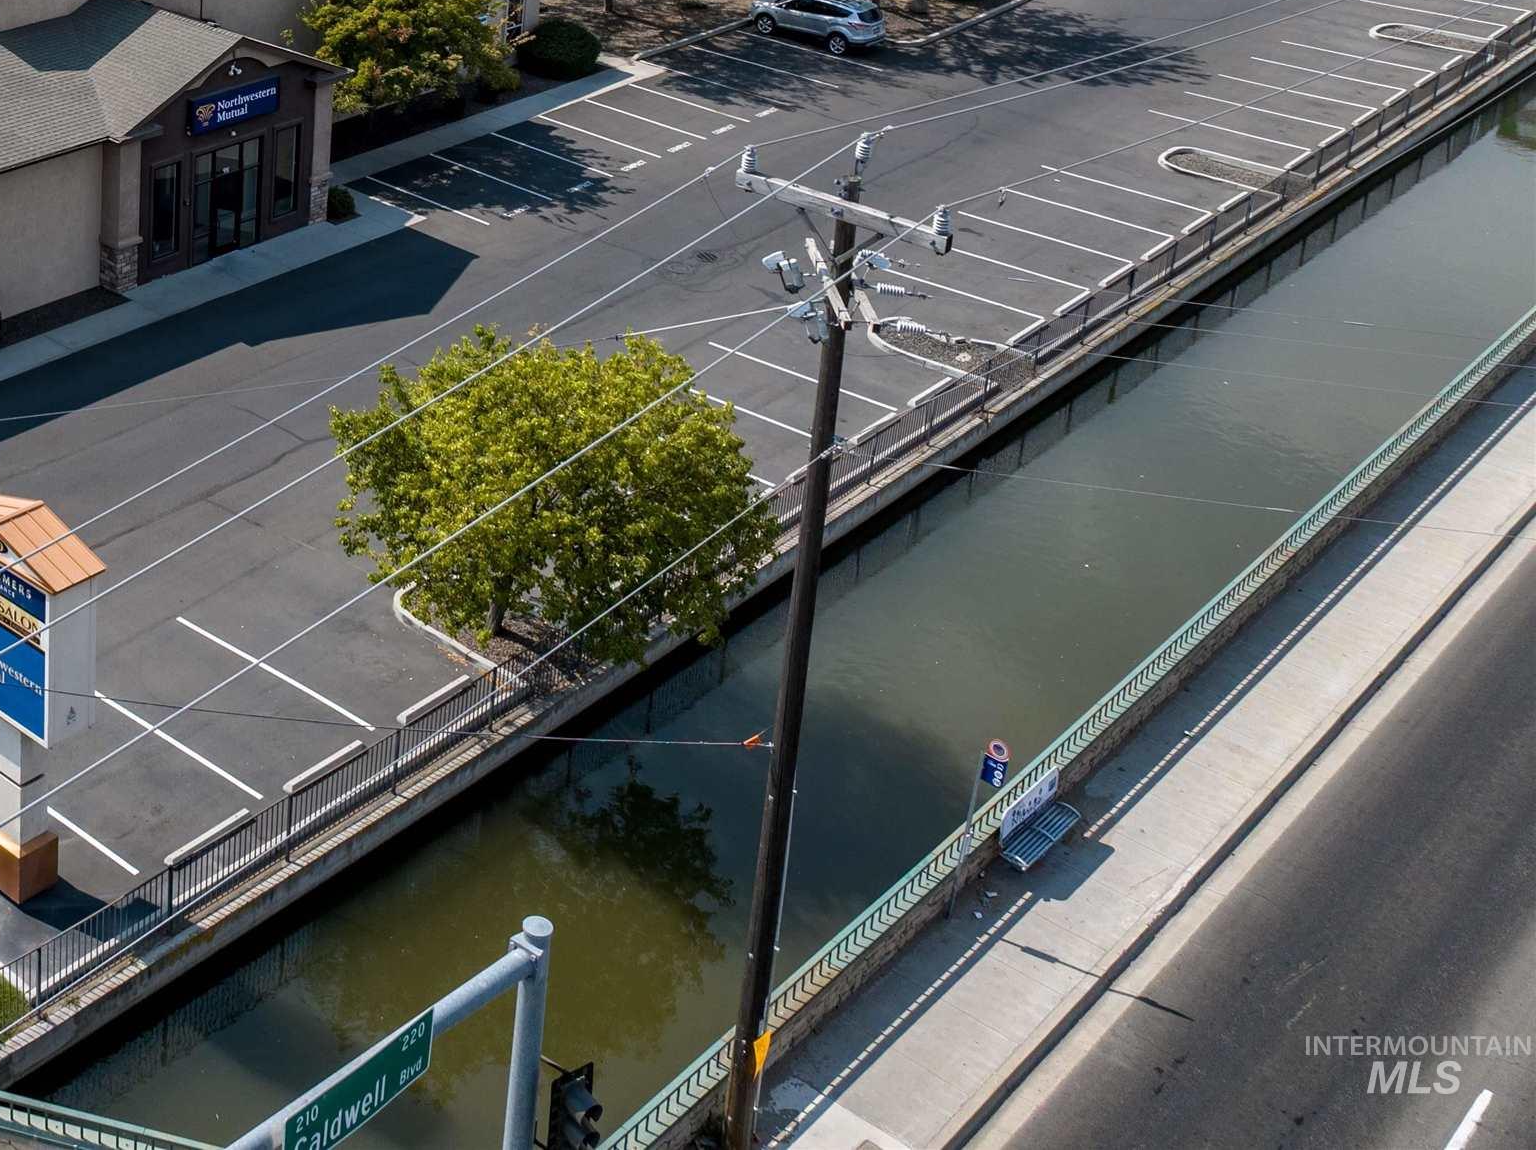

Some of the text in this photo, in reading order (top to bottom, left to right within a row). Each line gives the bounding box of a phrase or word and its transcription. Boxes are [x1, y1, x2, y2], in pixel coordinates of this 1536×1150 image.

[217, 86, 277, 111] Northwestern
[217, 103, 248, 123] Mutual
[295, 1021, 425, 1134] 210 220
[399, 1055, 423, 1087] Blvd
